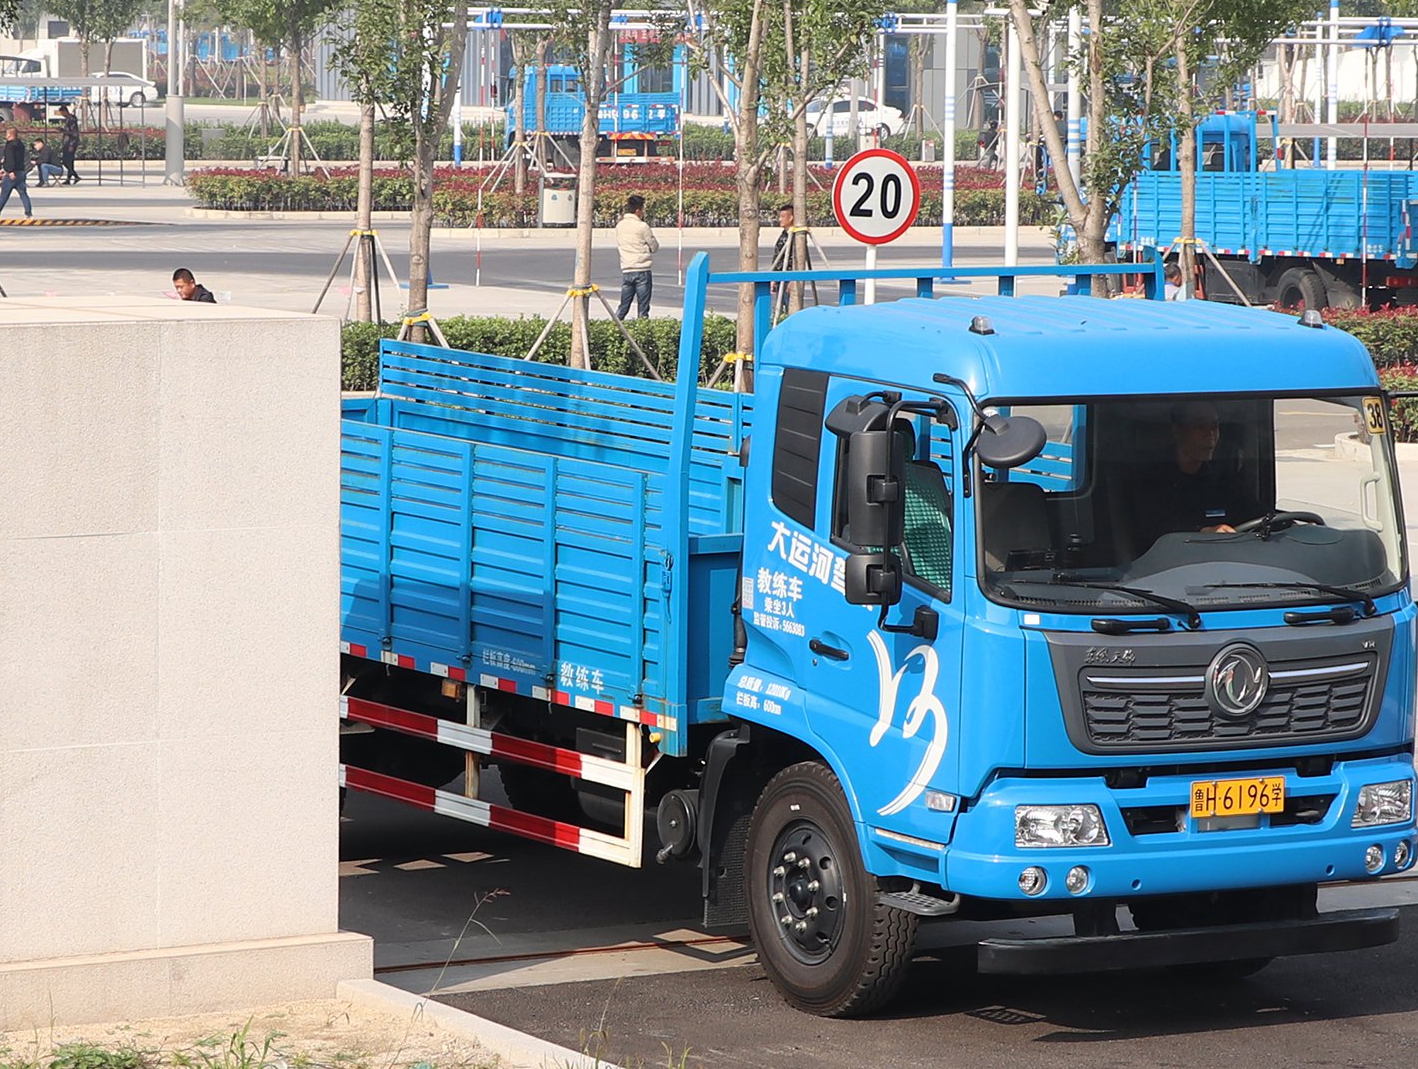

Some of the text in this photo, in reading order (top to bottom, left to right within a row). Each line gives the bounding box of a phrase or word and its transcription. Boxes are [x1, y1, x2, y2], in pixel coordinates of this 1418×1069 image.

[849, 172, 902, 219] 20
[1367, 403, 1383, 429] 38
[757, 567, 803, 602] 教练车
[560, 660, 605, 695] 教练车
